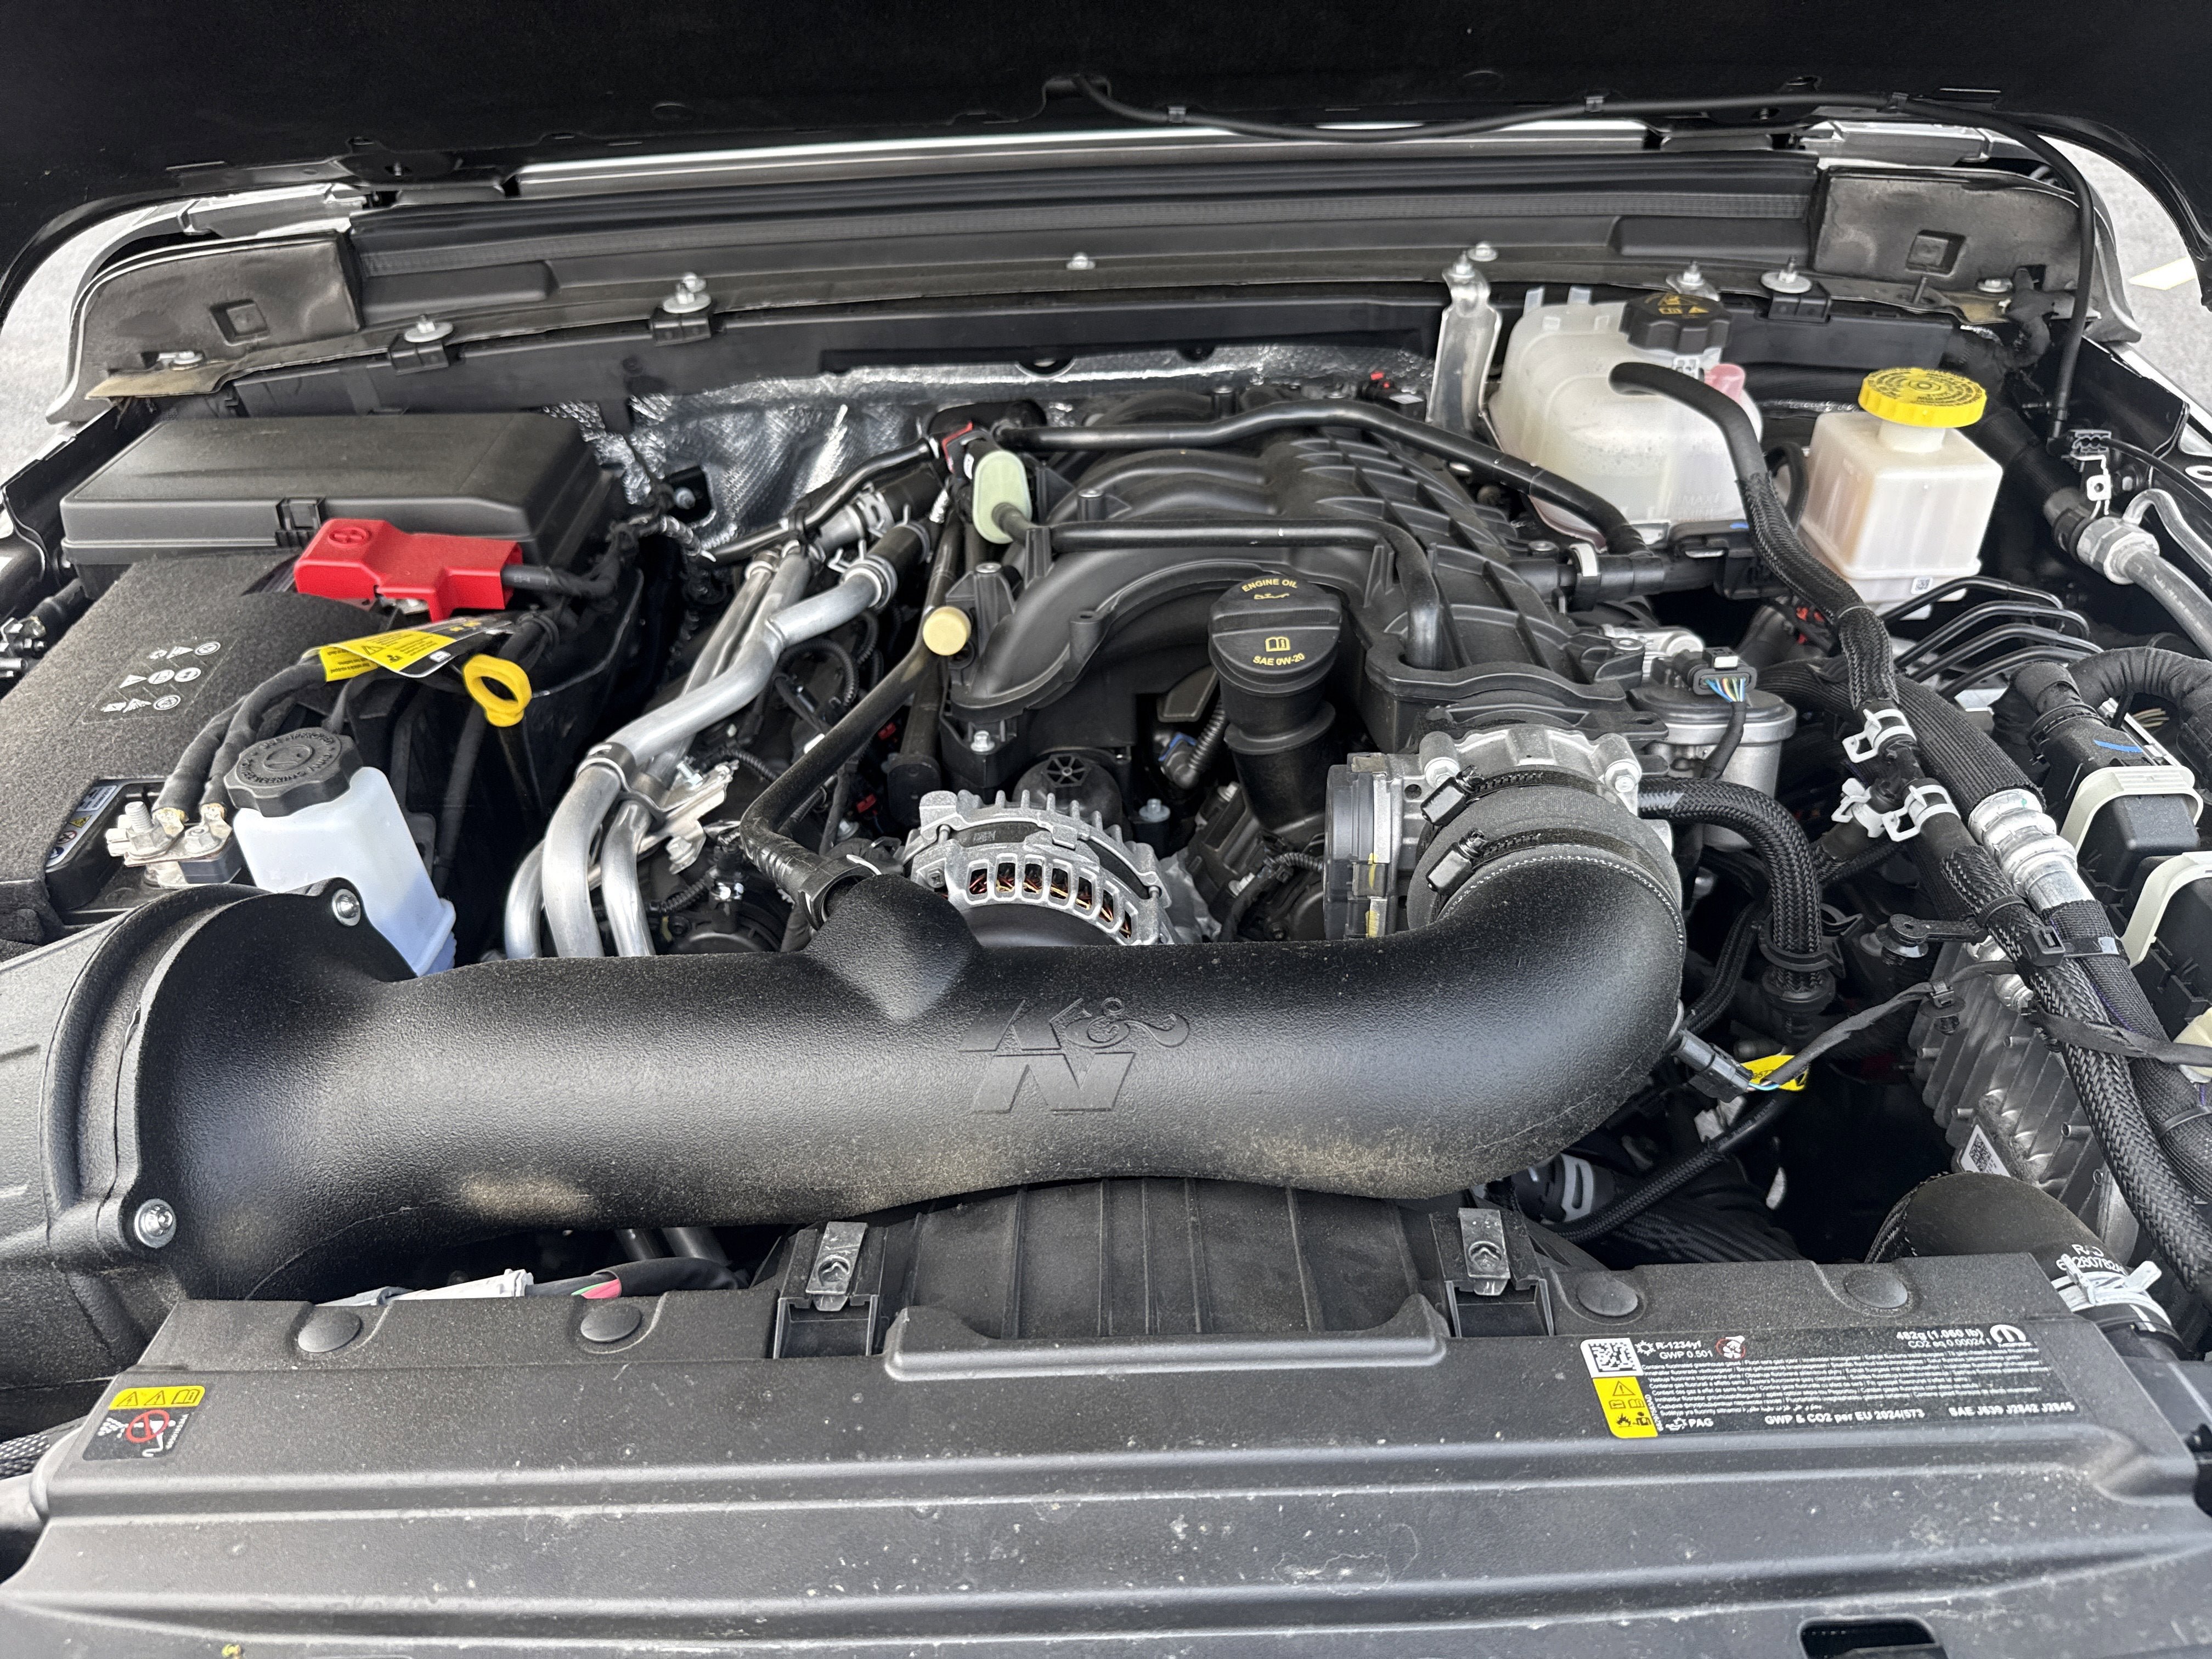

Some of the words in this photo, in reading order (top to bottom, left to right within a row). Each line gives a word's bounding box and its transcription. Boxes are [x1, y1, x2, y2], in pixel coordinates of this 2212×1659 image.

[1242, 579, 1279, 592] ENGINE
[1282, 579, 1297, 588] OIL
[1252, 656, 1274, 666] SAE
[1276, 653, 1306, 665] 0W-20
[2071, 1244, 2104, 1257] RD
[1896, 1329, 1926, 1341] 482g
[1927, 1328, 1964, 1340] (1.060
[1965, 1327, 1984, 1340] lb)
[1655, 1340, 1702, 1350] R-1234yf
[1908, 1339, 1931, 1349] CO2
[1659, 1350, 1684, 1360] GWP
[1686, 1349, 1713, 1359] 0.501
[1948, 1406, 1976, 1417] SAE
[1688, 1417, 1714, 1428] PAG
[1764, 1414, 1793, 1426] GWP
[1807, 1412, 1833, 1424] CO2
[1833, 1412, 1853, 1424] per
[1854, 1410, 1873, 1421] EU
